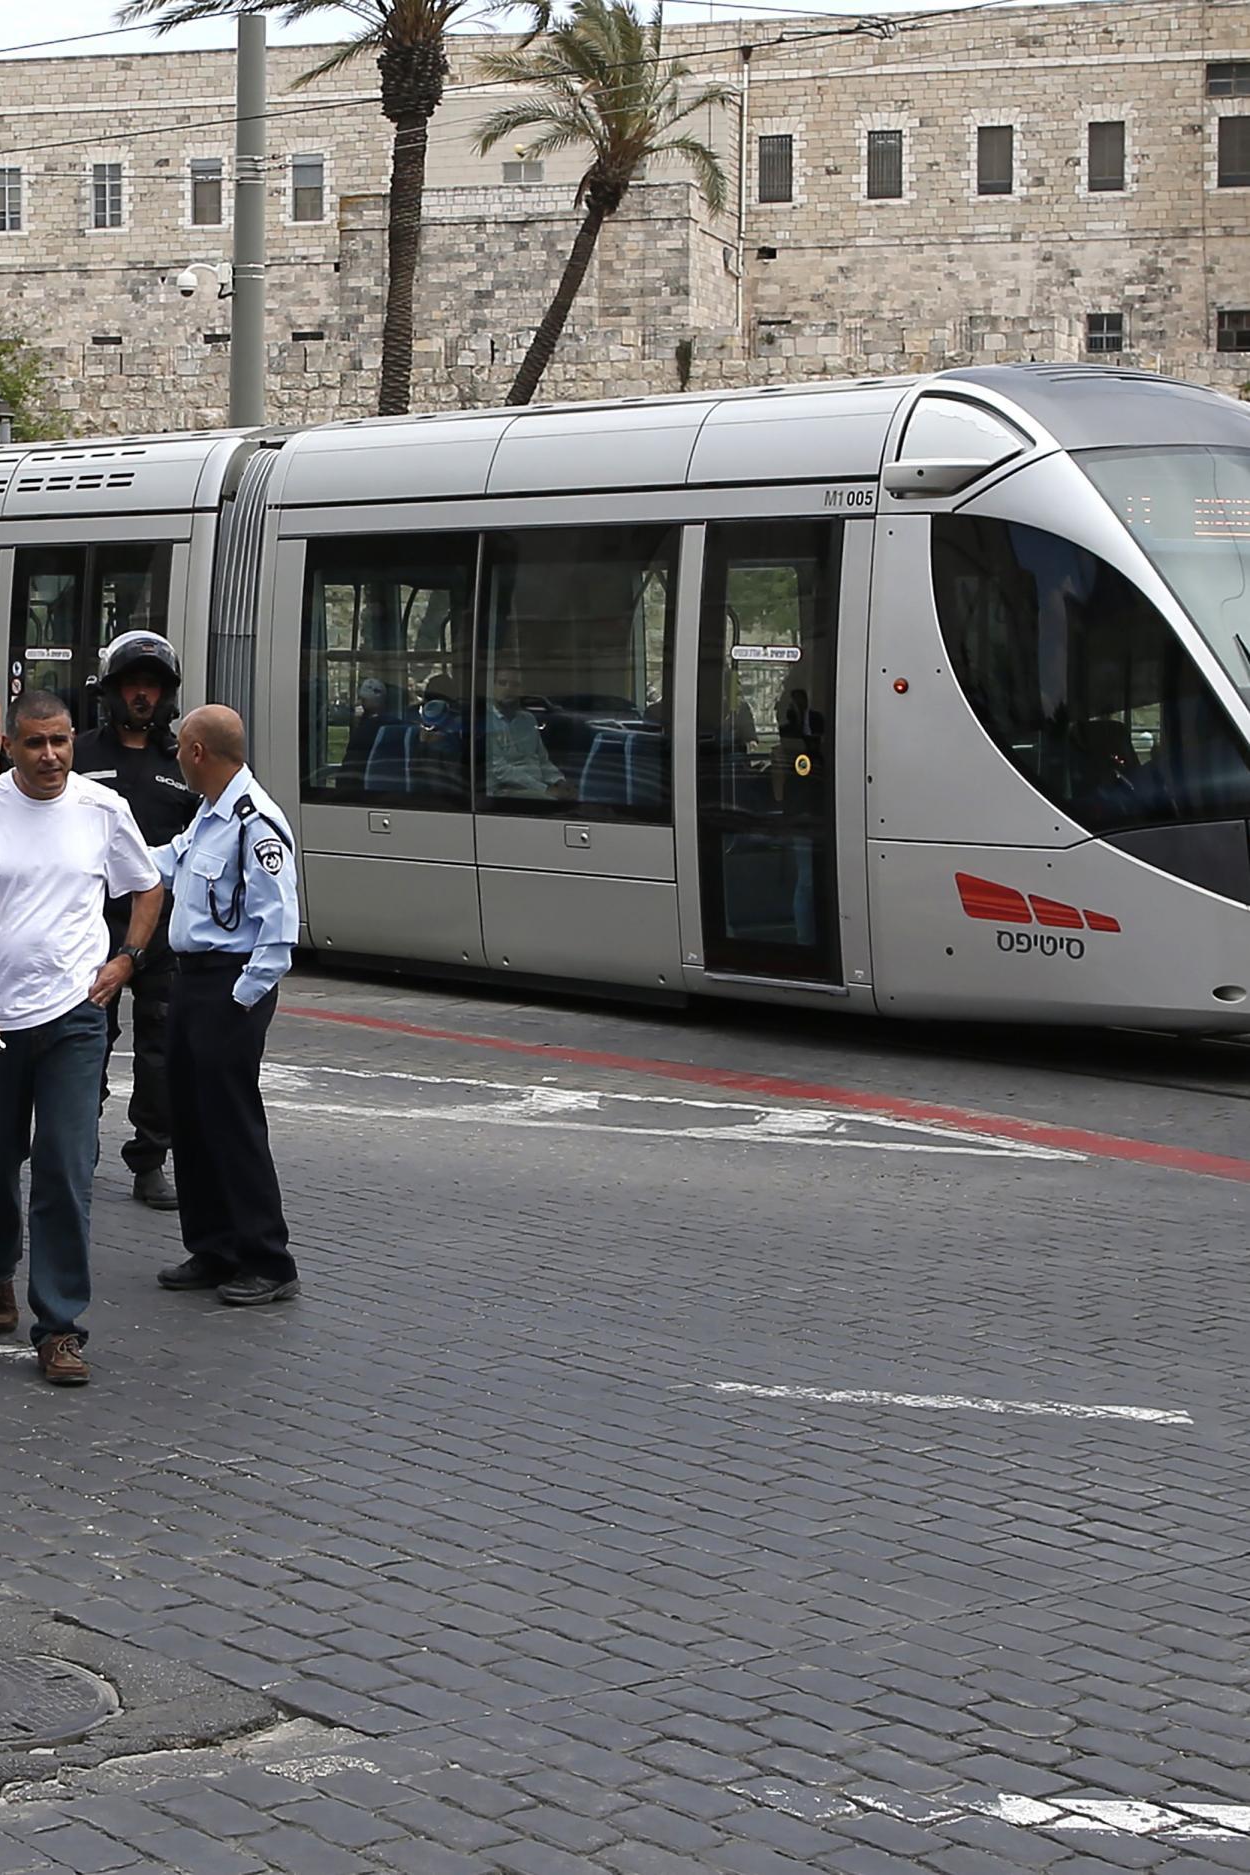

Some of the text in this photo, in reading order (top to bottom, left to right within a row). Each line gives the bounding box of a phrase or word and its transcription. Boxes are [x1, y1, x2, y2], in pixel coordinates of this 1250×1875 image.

[824, 490, 874, 506] M1 005
[996, 930, 1085, 960] סיטיפס
